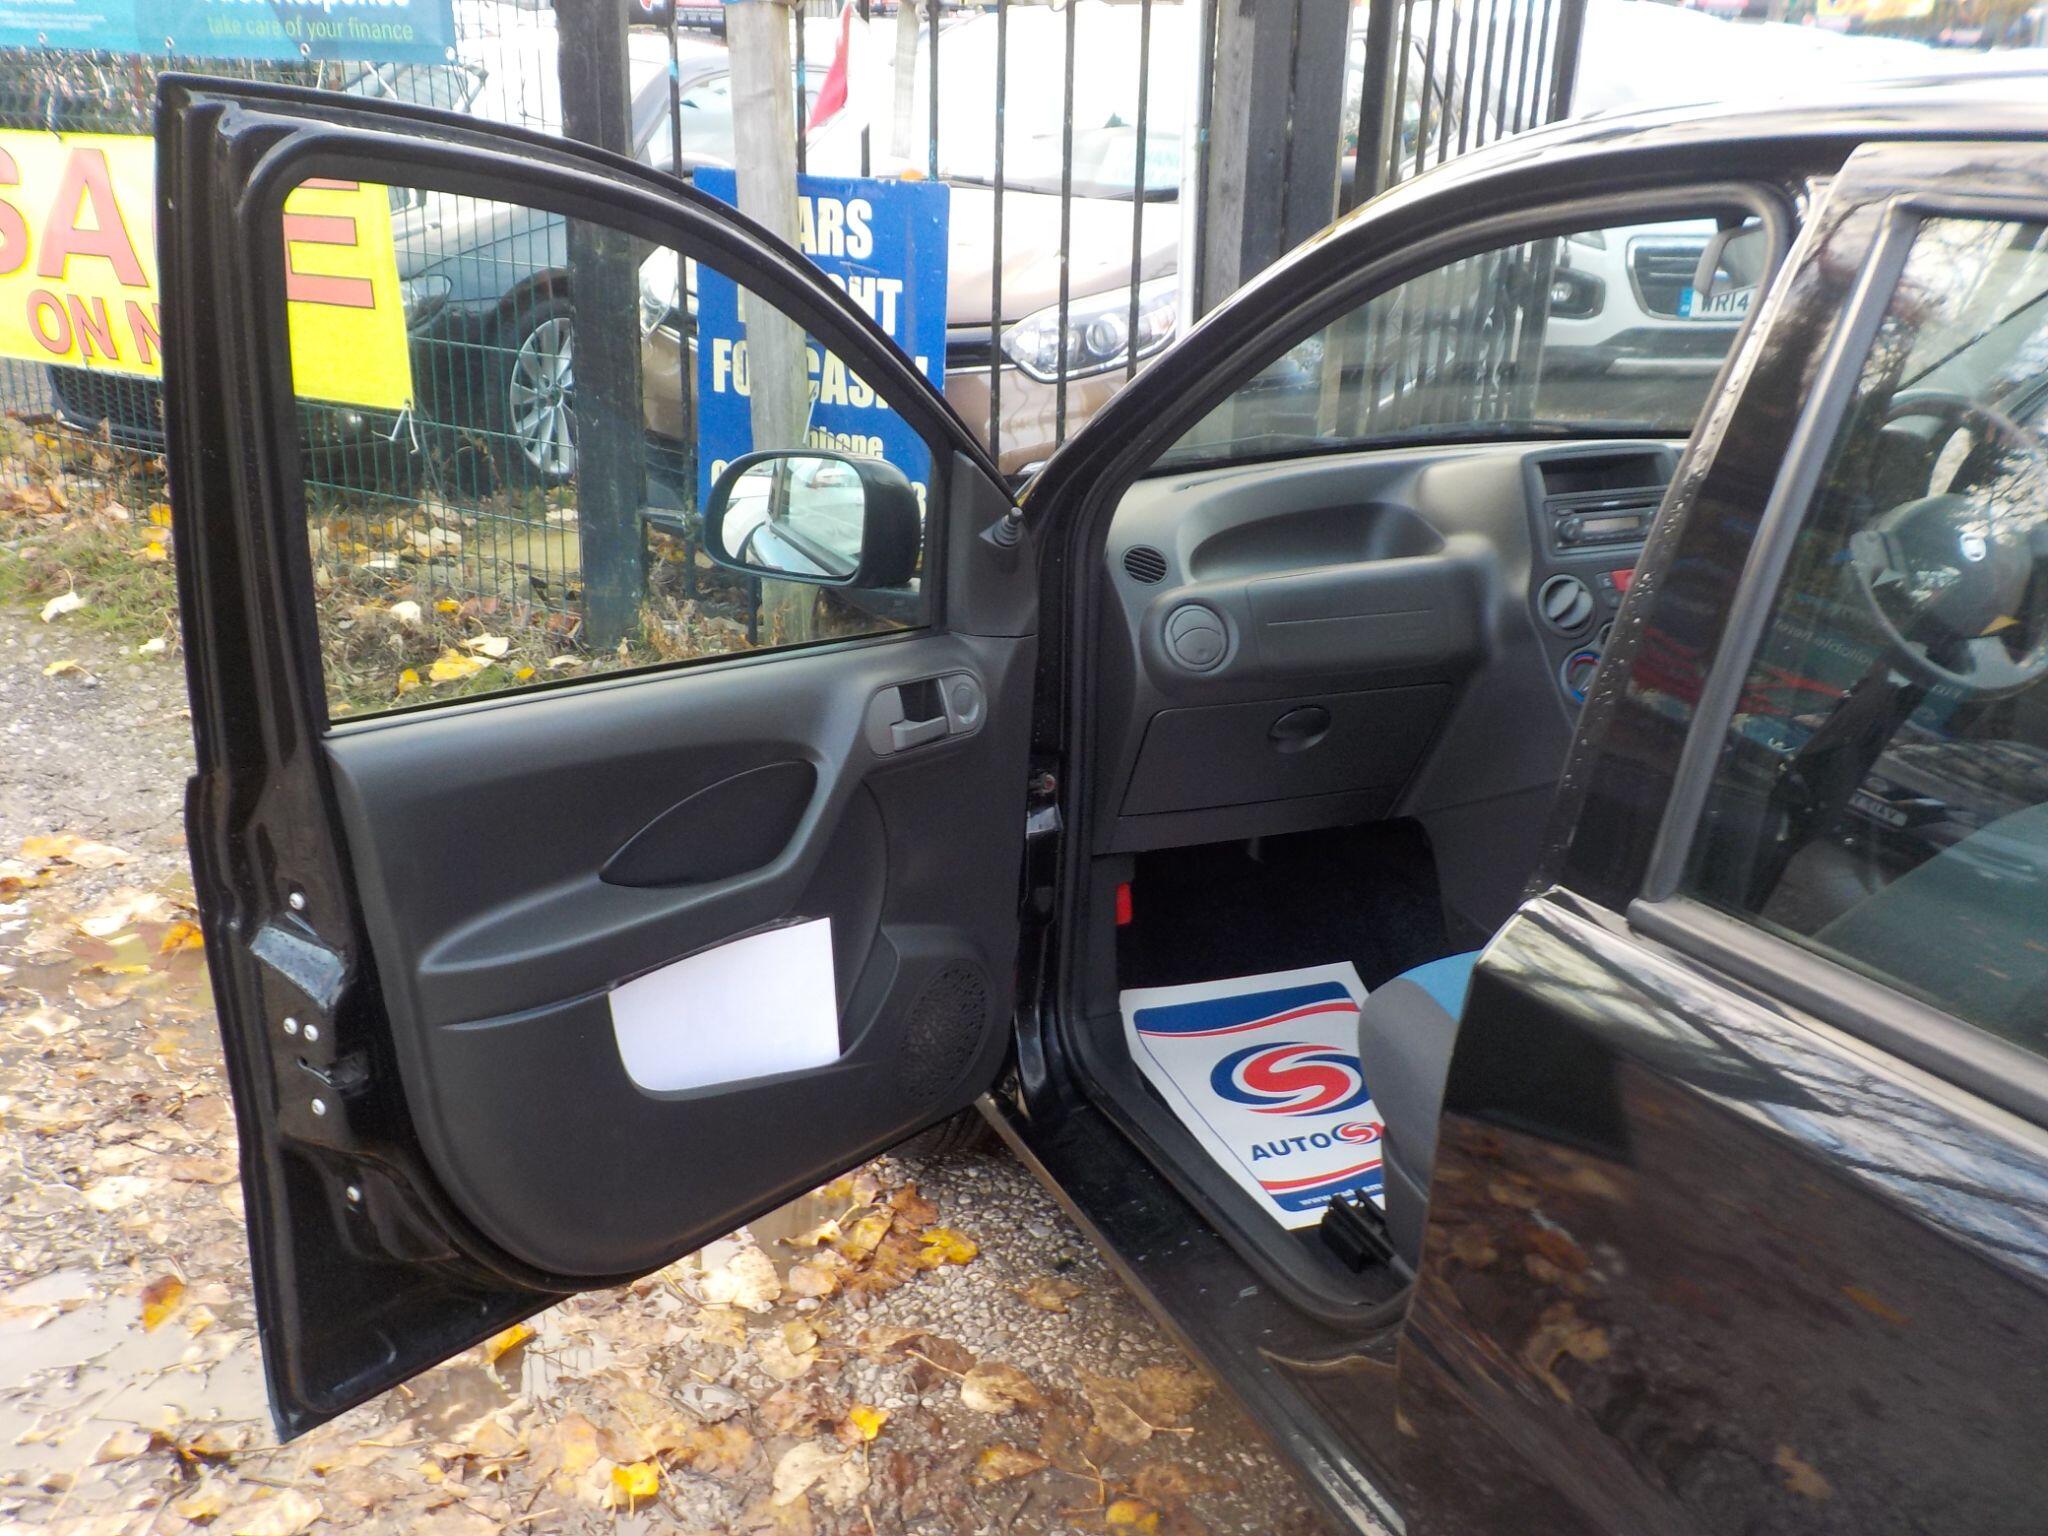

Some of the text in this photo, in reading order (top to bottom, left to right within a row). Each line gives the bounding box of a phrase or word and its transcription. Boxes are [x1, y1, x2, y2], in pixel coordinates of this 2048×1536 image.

[207, 15, 413, 41] take care of your finance
[798, 196, 873, 259] ARS
[27, 289, 118, 360] ON
[713, 338, 751, 397] FO
